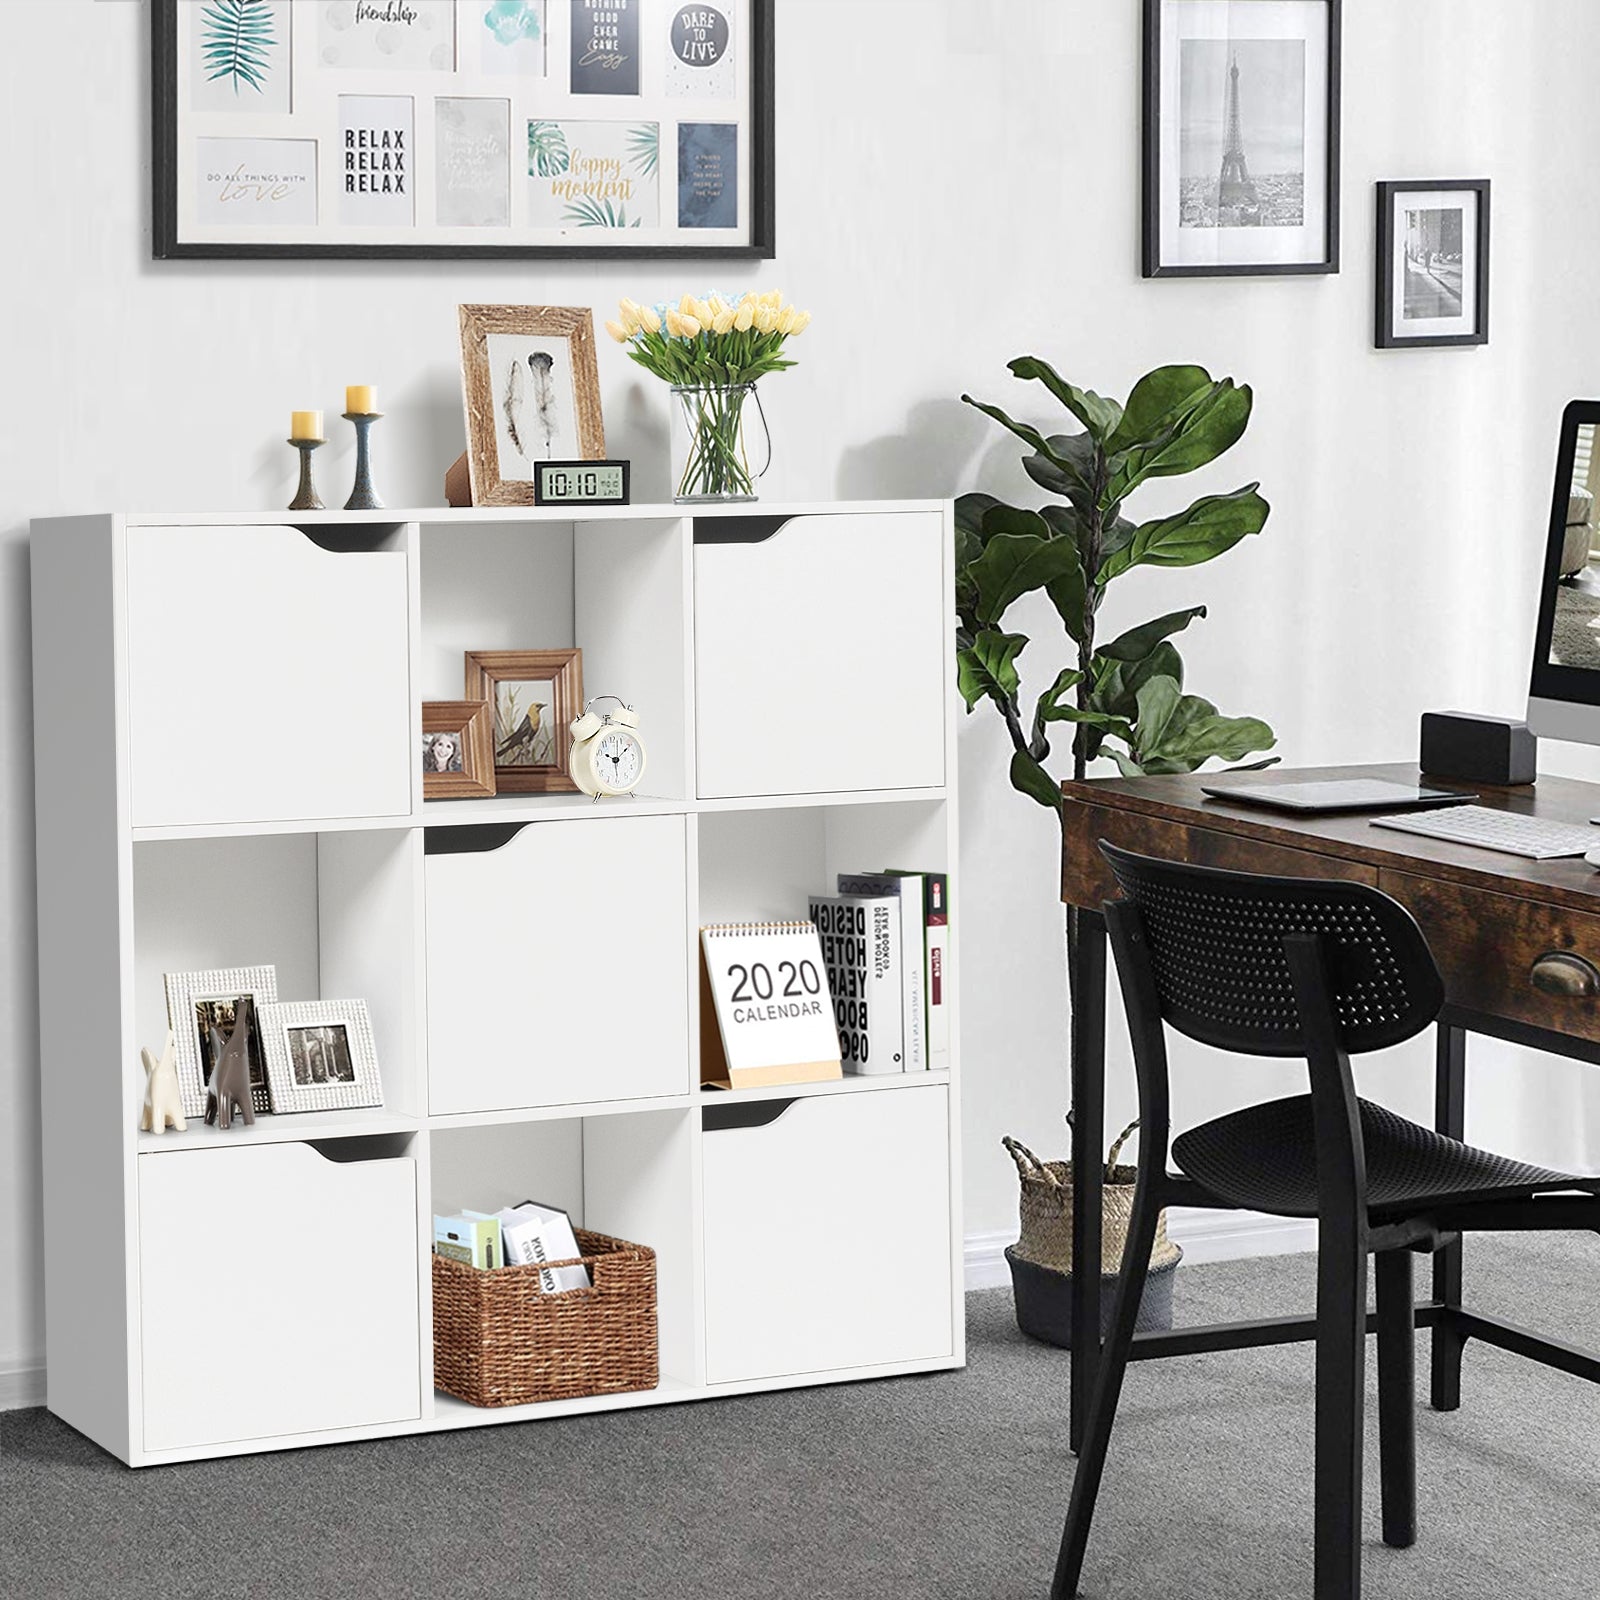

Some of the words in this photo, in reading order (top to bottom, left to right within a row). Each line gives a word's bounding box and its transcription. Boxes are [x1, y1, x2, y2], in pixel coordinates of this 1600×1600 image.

[593, 12, 618, 23] GOOD
[681, 11, 716, 29] DARE
[593, 25, 618, 37] EVER
[692, 28, 706, 41] TO
[592, 39, 619, 51] CAME
[681, 39, 718, 60] LIVE
[345, 129, 405, 148] RELAX
[345, 151, 405, 170] RELAX
[570, 147, 621, 180] happy
[207, 173, 221, 182] DO
[225, 174, 241, 182] ALL
[245, 174, 279, 182] THINGS
[282, 175, 306, 183] WITH
[219, 163, 297, 202] love
[345, 173, 405, 192] RELAX
[551, 177, 637, 202] moment
[549, 472, 597, 497] 10:10
[727, 959, 821, 1003] 2020
[733, 1000, 823, 1024] CALENDAR
